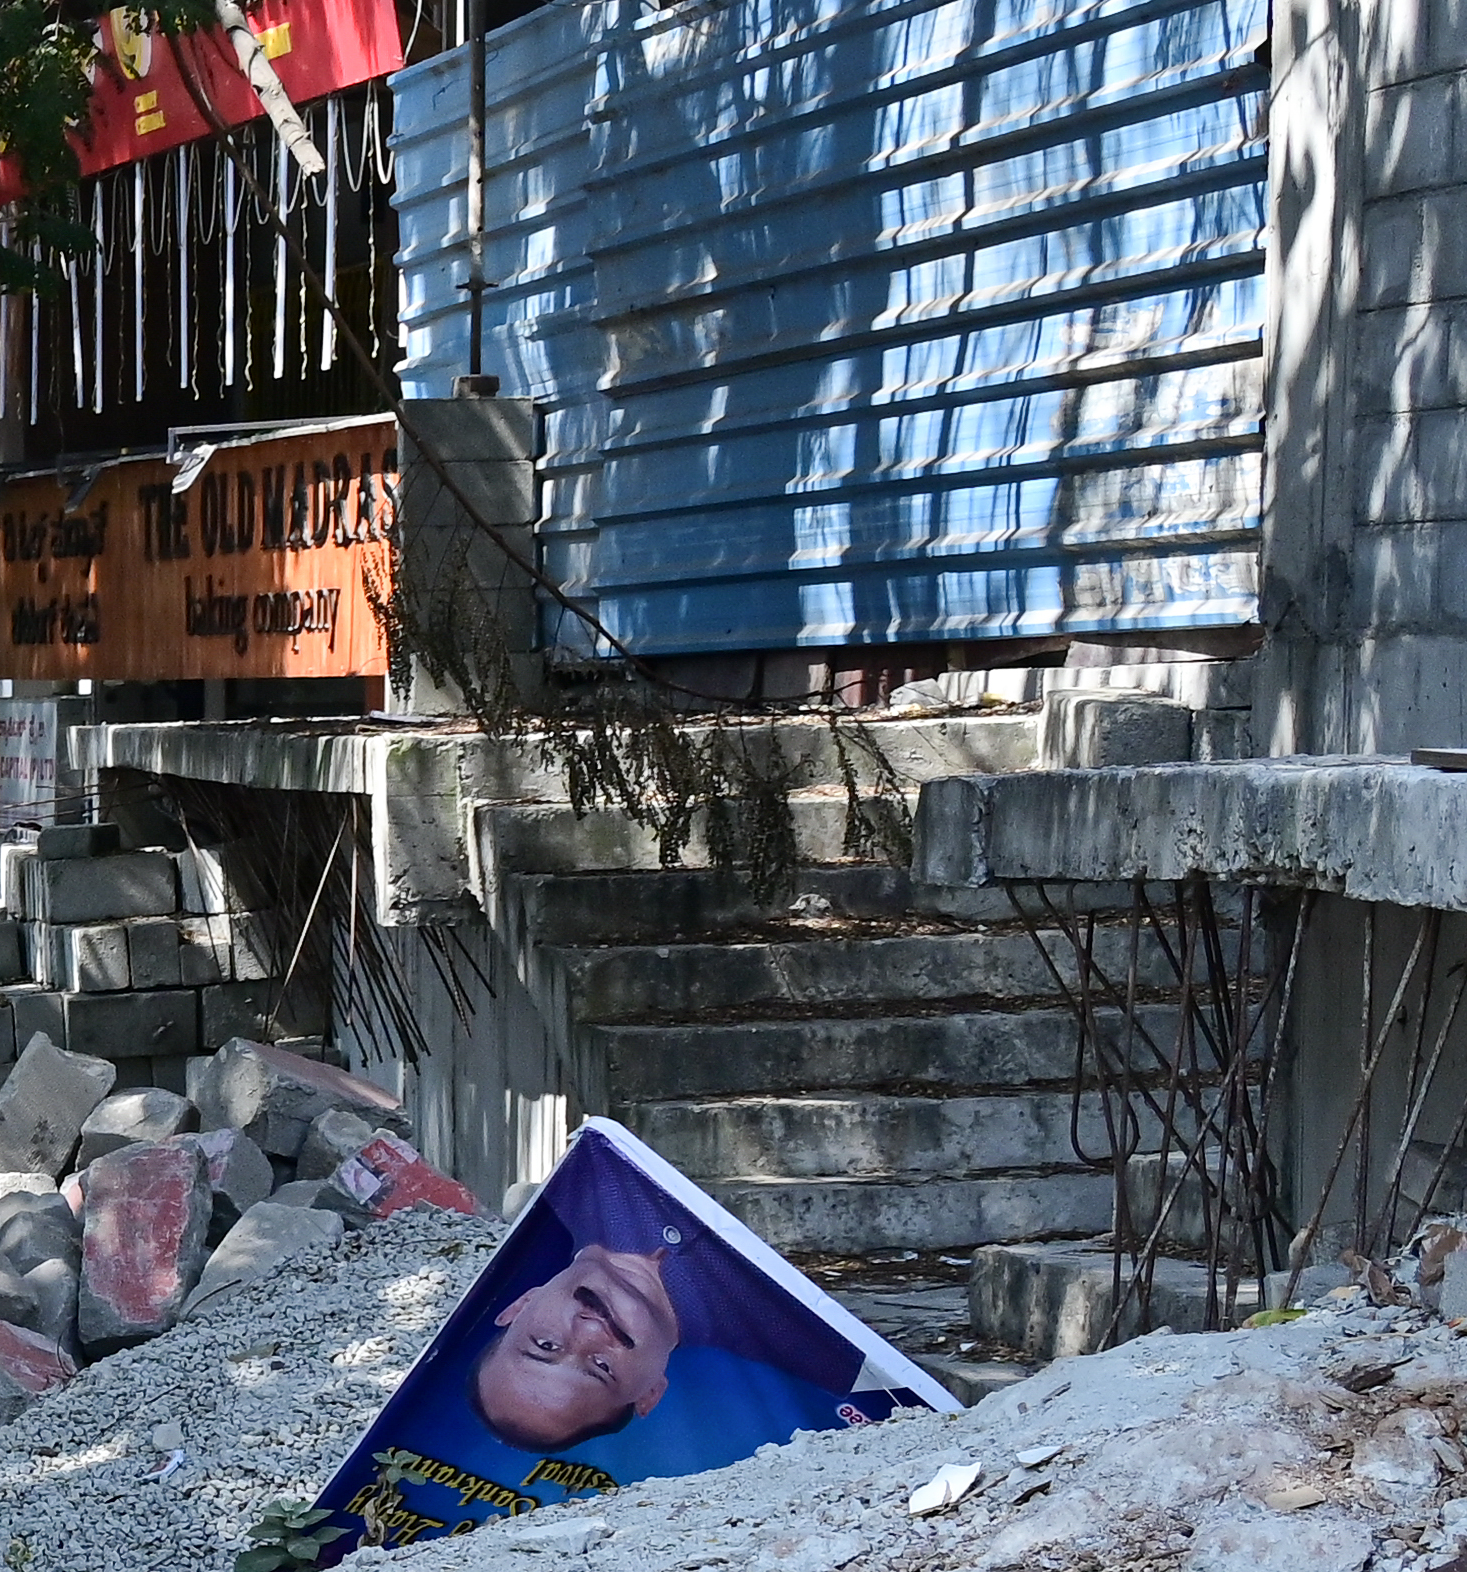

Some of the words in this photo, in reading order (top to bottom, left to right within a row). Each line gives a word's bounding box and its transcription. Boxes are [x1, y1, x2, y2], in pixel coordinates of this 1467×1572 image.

[138, 481, 190, 562] THE
[201, 469, 256, 557] OLD
[260, 447, 401, 551] MADRAS
[253, 588, 341, 654] company
[385, 1446, 538, 1517] Sankran
[519, 1458, 620, 1495] estival
